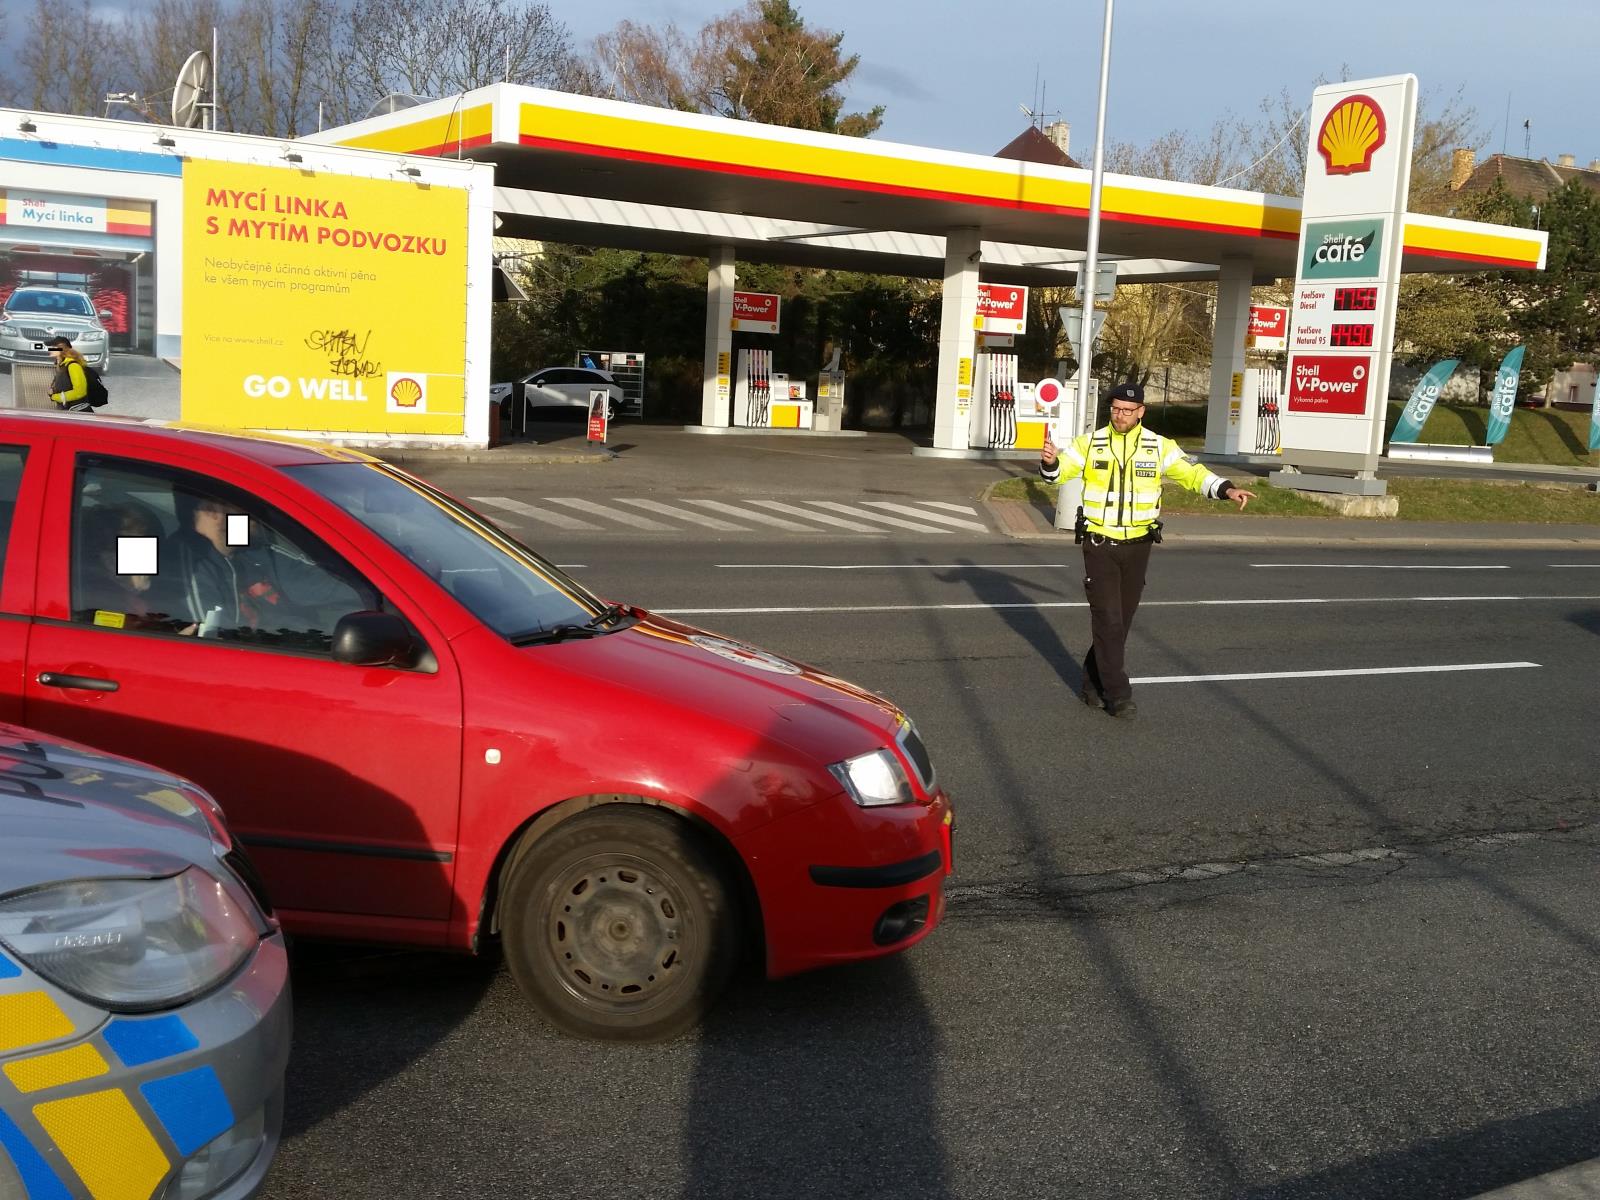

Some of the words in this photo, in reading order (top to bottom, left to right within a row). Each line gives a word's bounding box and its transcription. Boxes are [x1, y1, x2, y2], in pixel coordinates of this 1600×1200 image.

[22, 199, 46, 208] Shell
[206, 188, 266, 211] MYCÍ
[274, 194, 348, 220] LINKA
[22, 208, 55, 222] Mycí
[59, 210, 94, 225] linka
[206, 215, 220, 235] S
[227, 217, 309, 243] MYTÍM
[317, 227, 448, 256] PODVOZKU
[1323, 232, 1344, 244] Shell
[1315, 235, 1365, 263] café
[204, 257, 272, 274] Neobyčejně
[275, 263, 311, 276] účinná
[314, 265, 348, 279] aktivní
[350, 270, 377, 283] pěna
[204, 272, 217, 284] ke
[221, 276, 249, 286] všem
[290, 282, 351, 294] programům
[1301, 290, 1326, 300] FuelSave
[734, 303, 769, 313] V-Power
[1299, 301, 1317, 310] Diesel
[1297, 326, 1322, 335] FuelSave
[1296, 337, 1317, 346] Natural
[1318, 336, 1327, 345] 95
[1296, 365, 1320, 376] Shell
[243, 374, 291, 399] GO
[298, 377, 368, 401] WELL
[1296, 377, 1359, 393] V-Power
[1413, 384, 1439, 422] café
[1500, 376, 1516, 416] café
